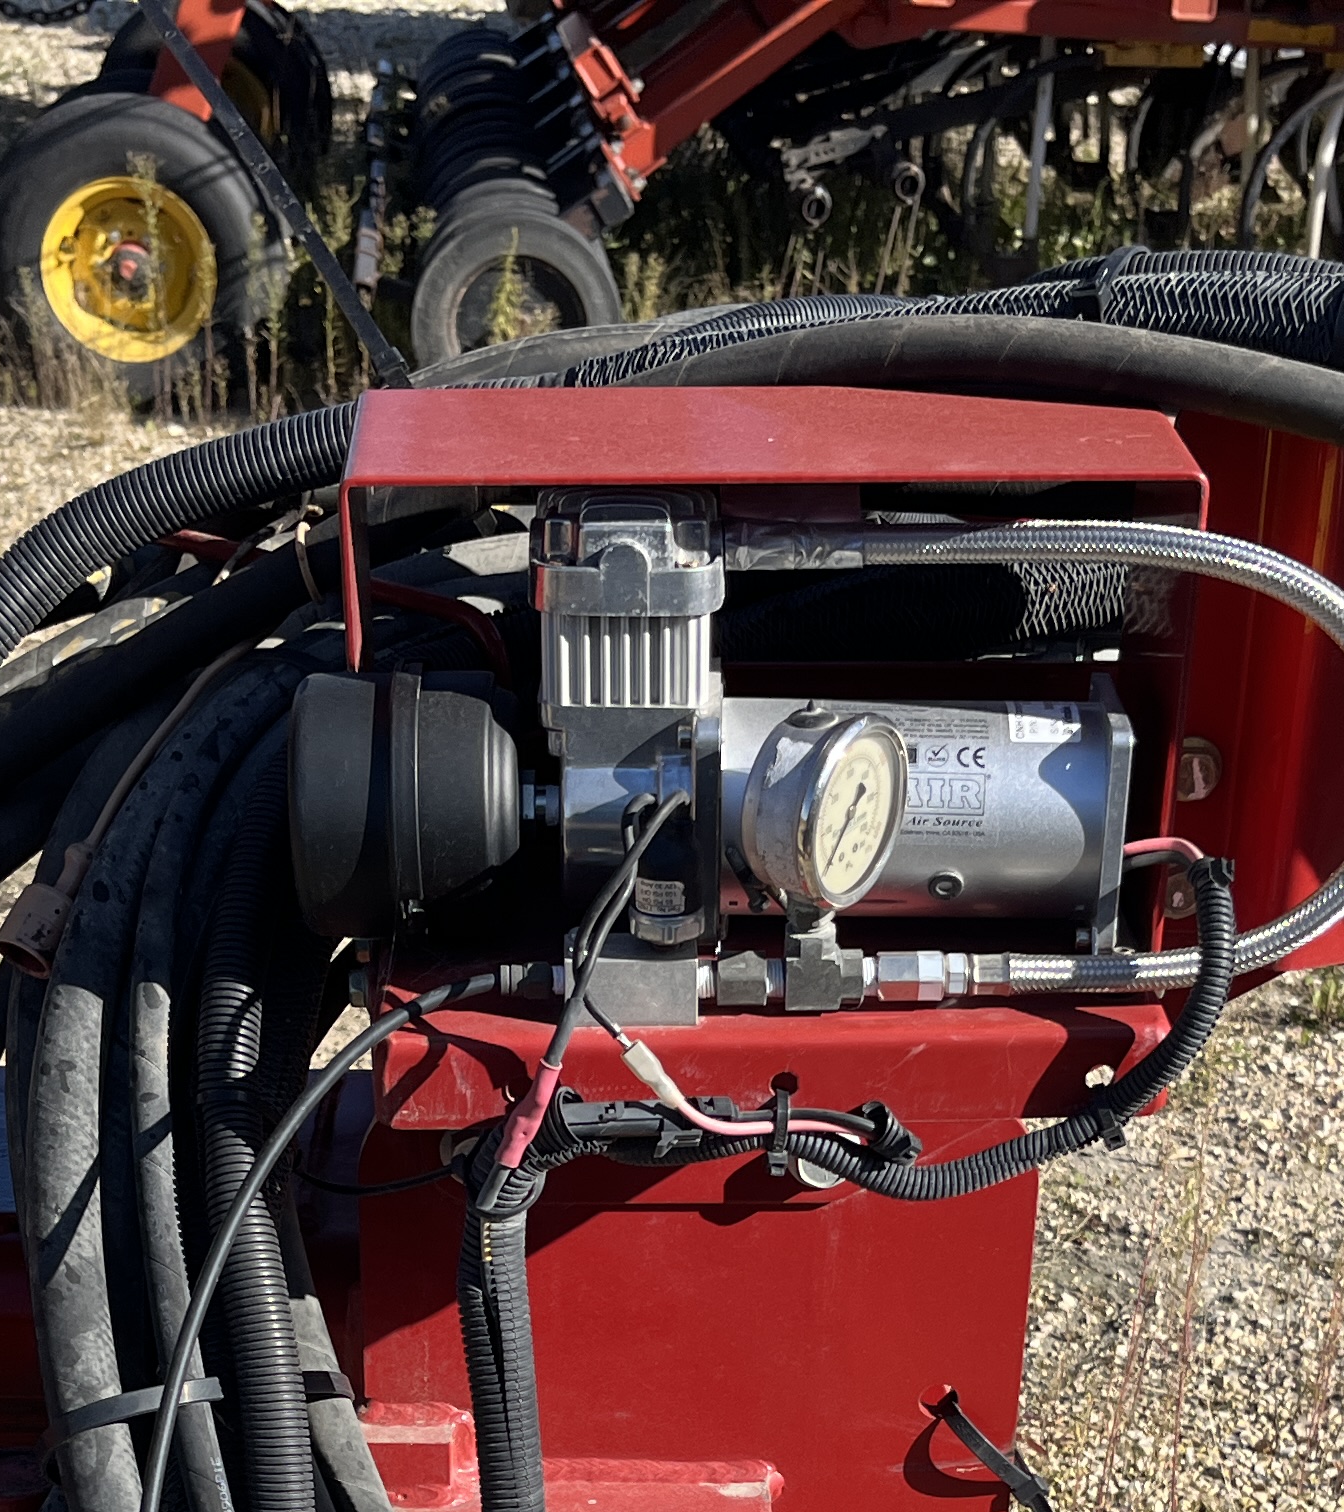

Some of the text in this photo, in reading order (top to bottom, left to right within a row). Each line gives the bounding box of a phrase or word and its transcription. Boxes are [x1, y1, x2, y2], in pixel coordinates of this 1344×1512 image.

[957, 746, 985, 768] CE
[906, 816, 983, 827] Air Source
